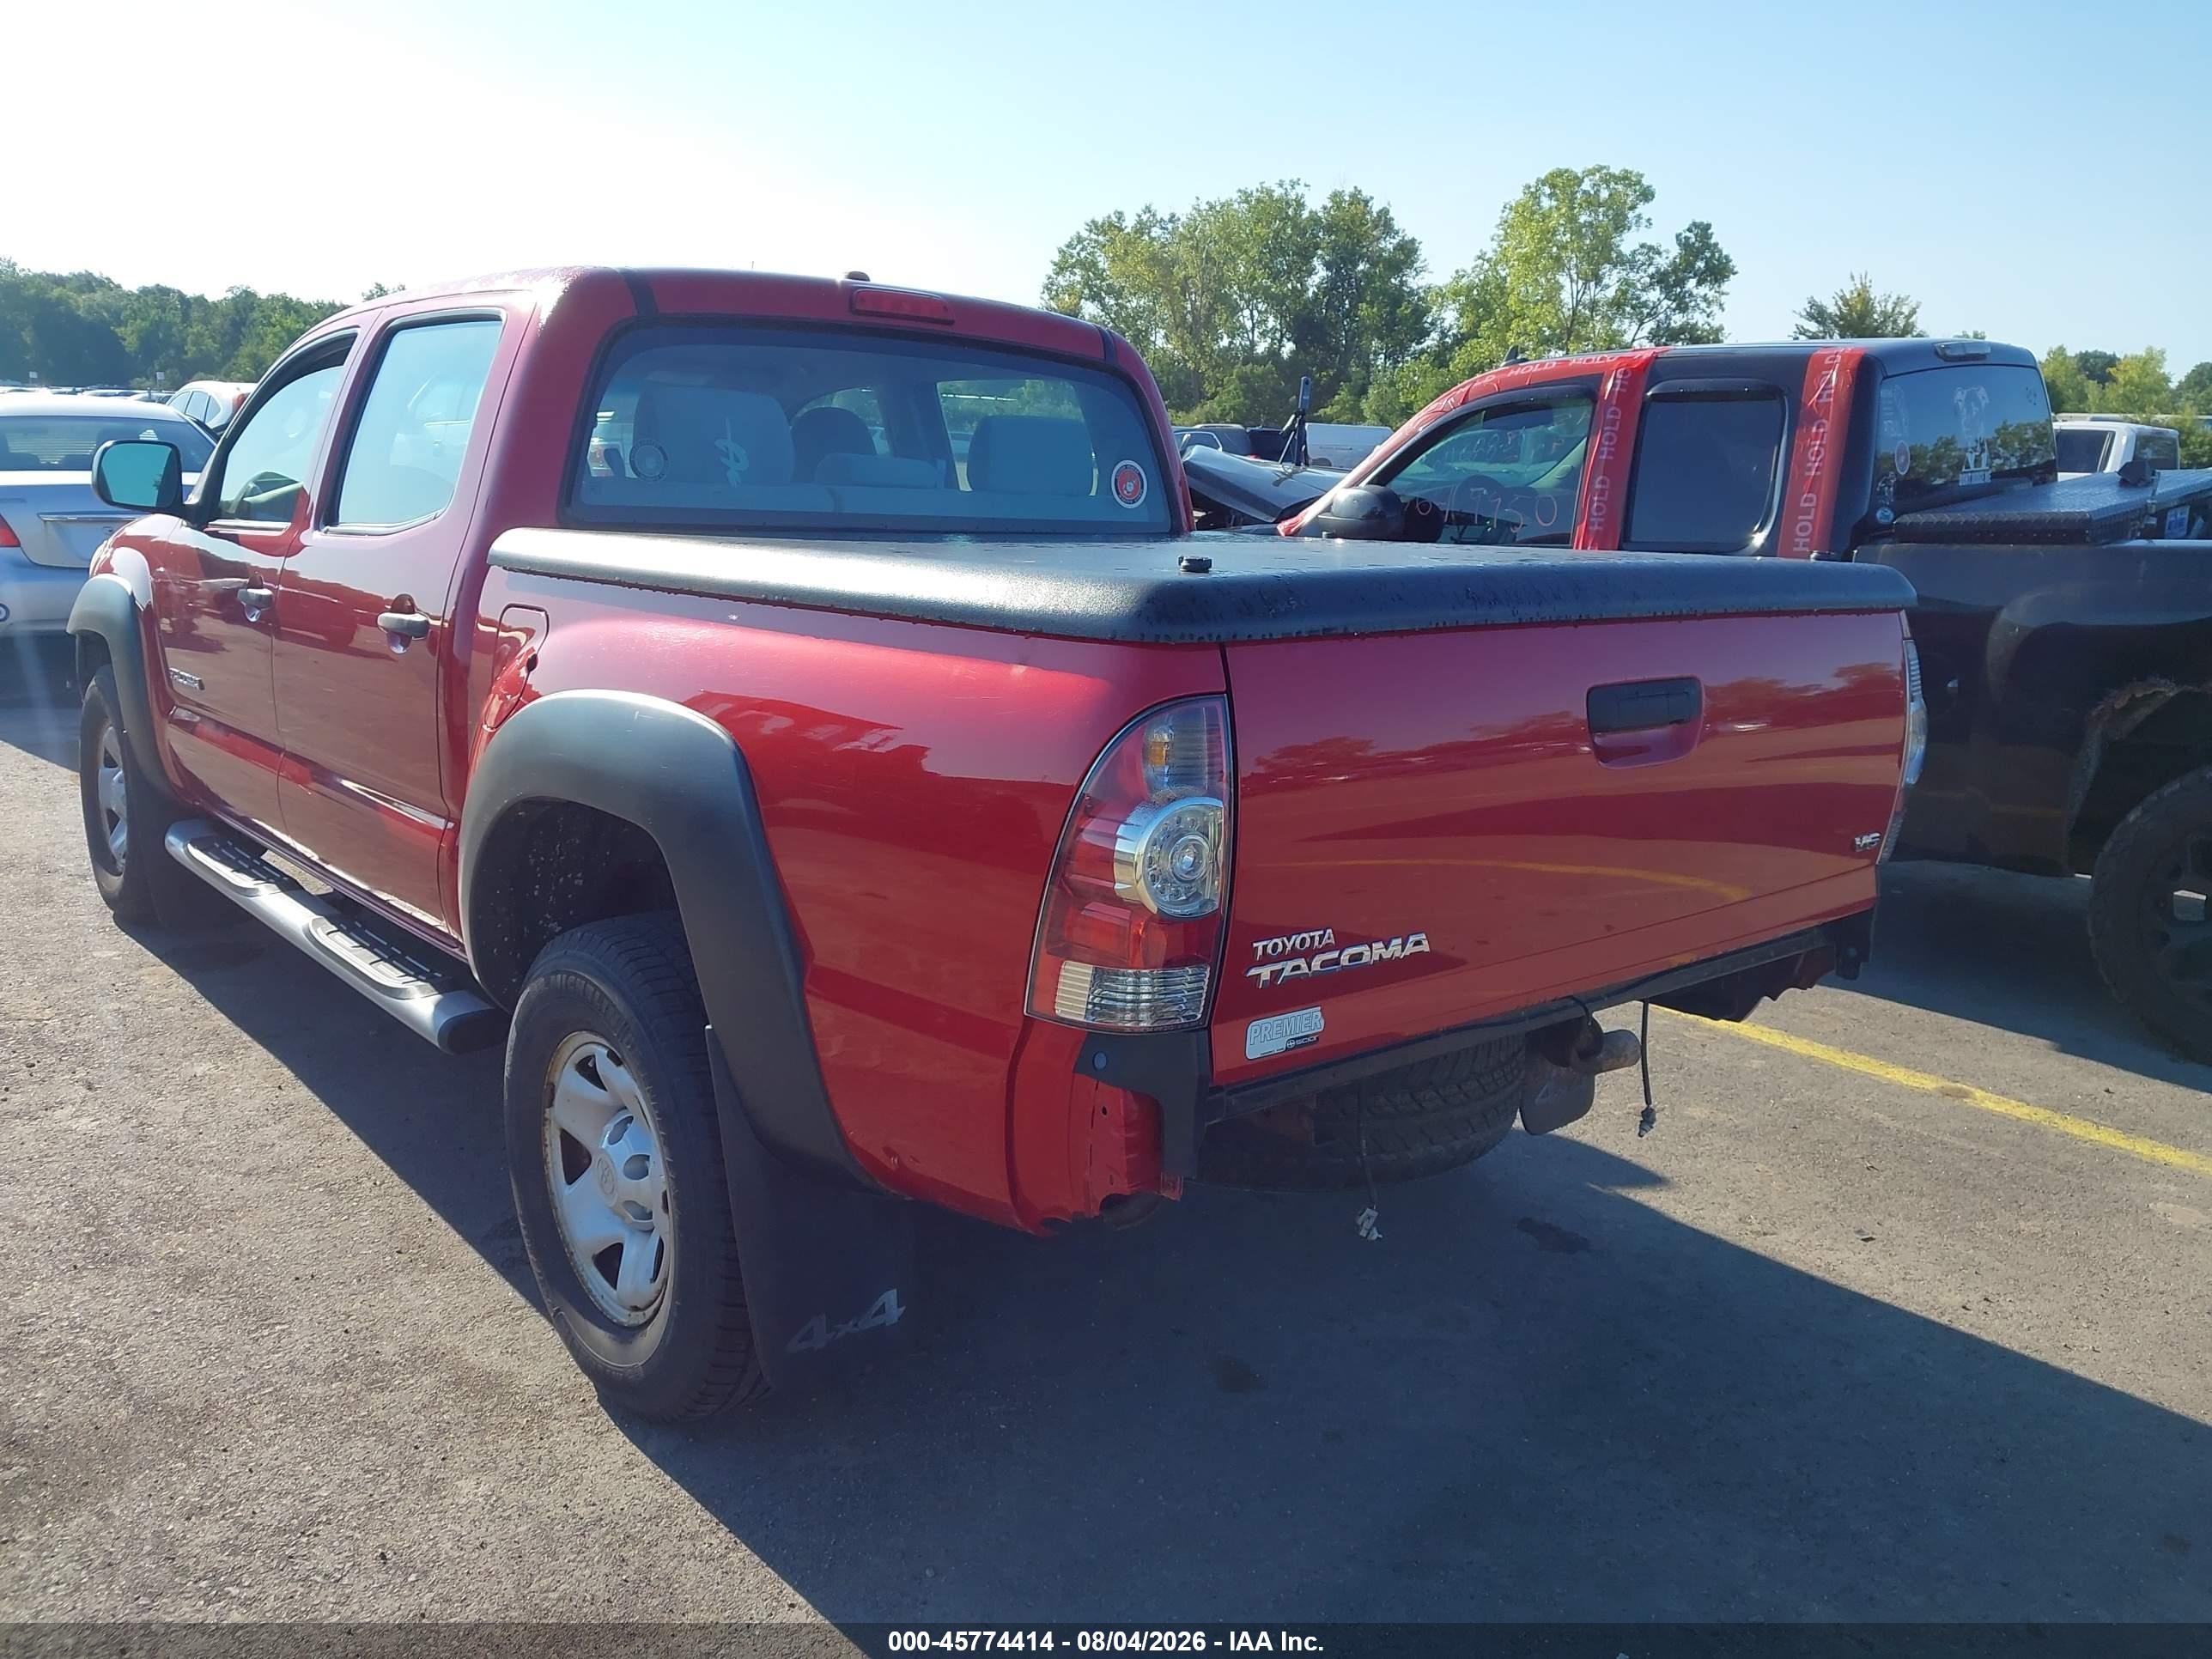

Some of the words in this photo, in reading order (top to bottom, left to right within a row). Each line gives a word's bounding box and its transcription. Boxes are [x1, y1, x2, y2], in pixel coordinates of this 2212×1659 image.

[1507, 361, 1557, 378] HOLD
[1599, 407, 1622, 459] HOLD
[1806, 419, 1828, 477] HOLD
[1589, 476, 1611, 531] HOLD
[1793, 492, 1817, 552] HOLD
[1246, 933, 1431, 989] TACOMA
[1252, 928, 1336, 961] TOYOTA
[1249, 1010, 1322, 1046] PREMIER
